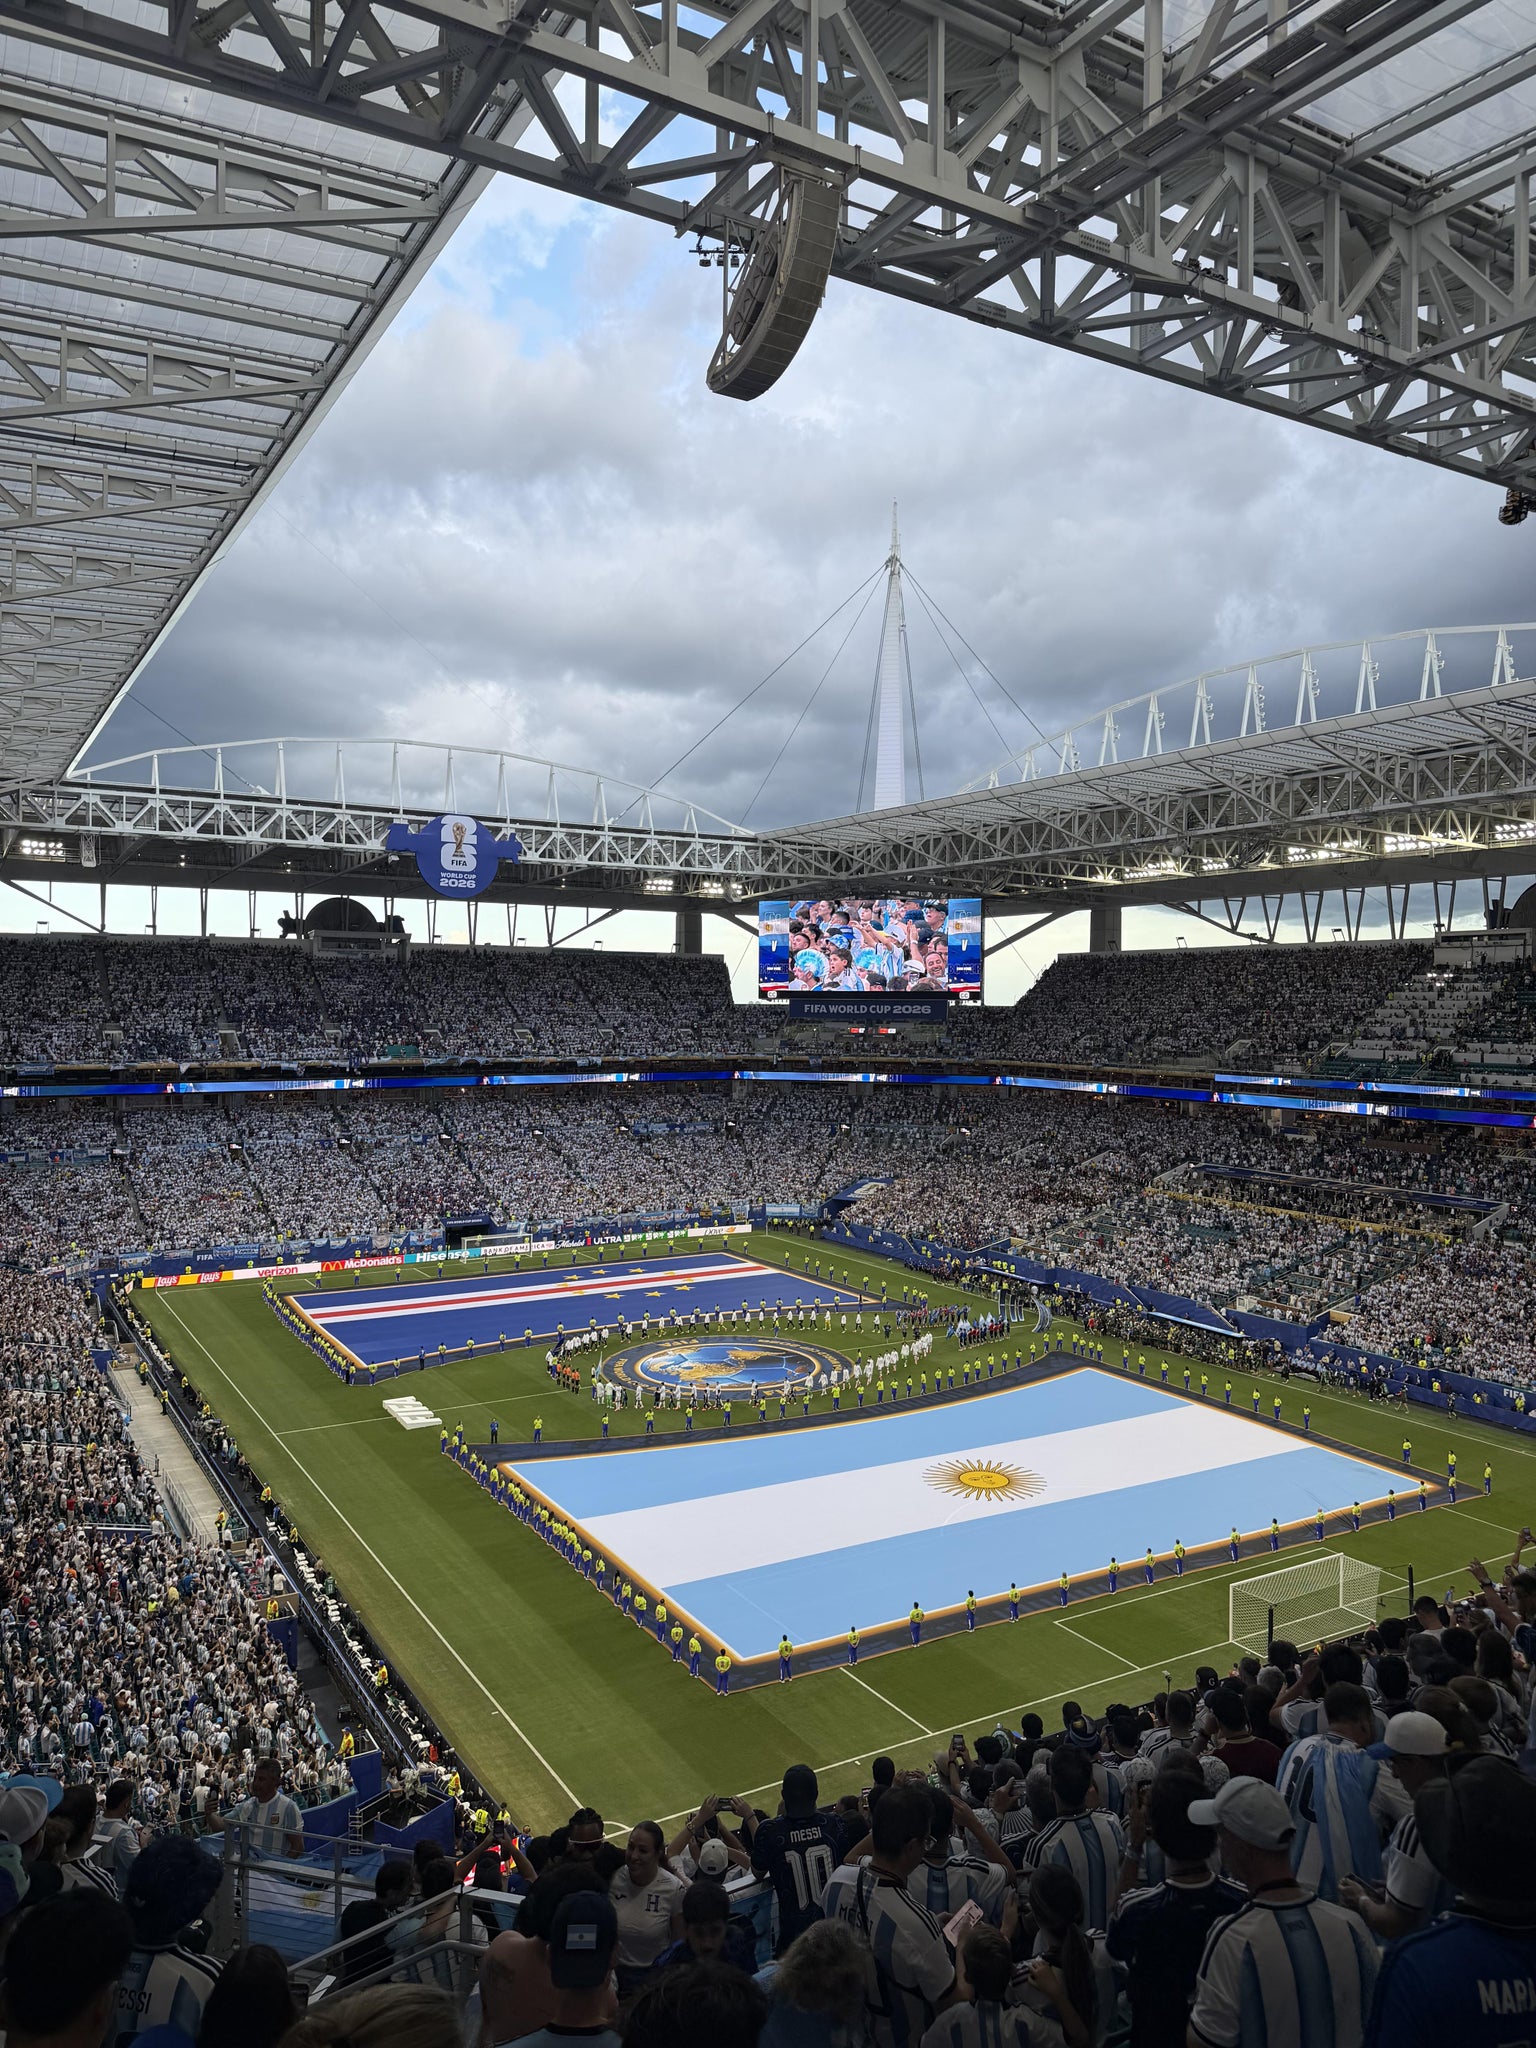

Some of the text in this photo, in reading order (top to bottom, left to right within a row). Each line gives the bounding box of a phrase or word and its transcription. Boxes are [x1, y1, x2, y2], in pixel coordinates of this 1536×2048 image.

[440, 878, 476, 888] 2026
[804, 1004, 932, 1014] FIFA WORLD CUP 2026
[594, 1235, 622, 1245] ULTRA
[196, 1254, 214, 1262] FIFA
[416, 1250, 469, 1262] Hisense
[344, 1256, 402, 1269] McDonald's
[200, 1272, 220, 1283] Lay's
[258, 1266, 298, 1278] verizon
[157, 1276, 177, 1286] Lay's
[1503, 1388, 1526, 1402] FIFA
[790, 1826, 822, 1844] MESSI
[784, 1844, 834, 1911] 10
[646, 1894, 660, 1912] H
